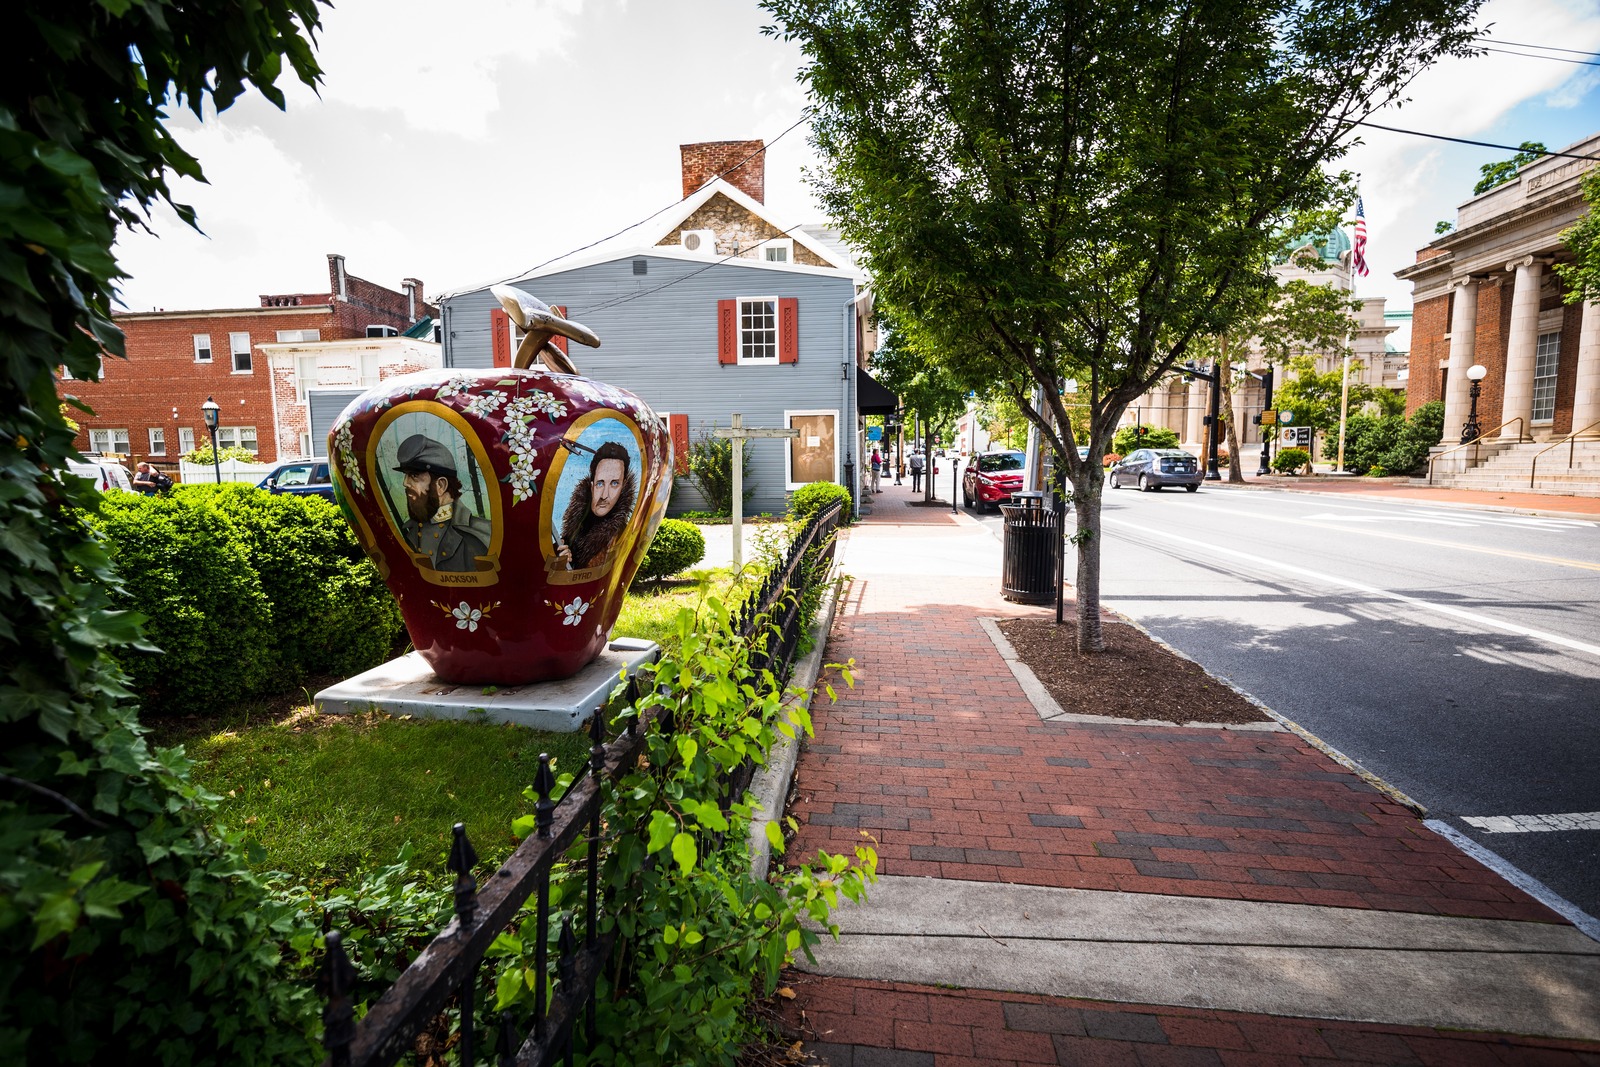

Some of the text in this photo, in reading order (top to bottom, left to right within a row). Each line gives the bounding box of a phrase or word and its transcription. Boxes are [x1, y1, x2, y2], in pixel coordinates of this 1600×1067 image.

[1544, 154, 1595, 185] UNITED
[440, 574, 479, 583] JACKSON
[572, 571, 592, 581] BYRD
